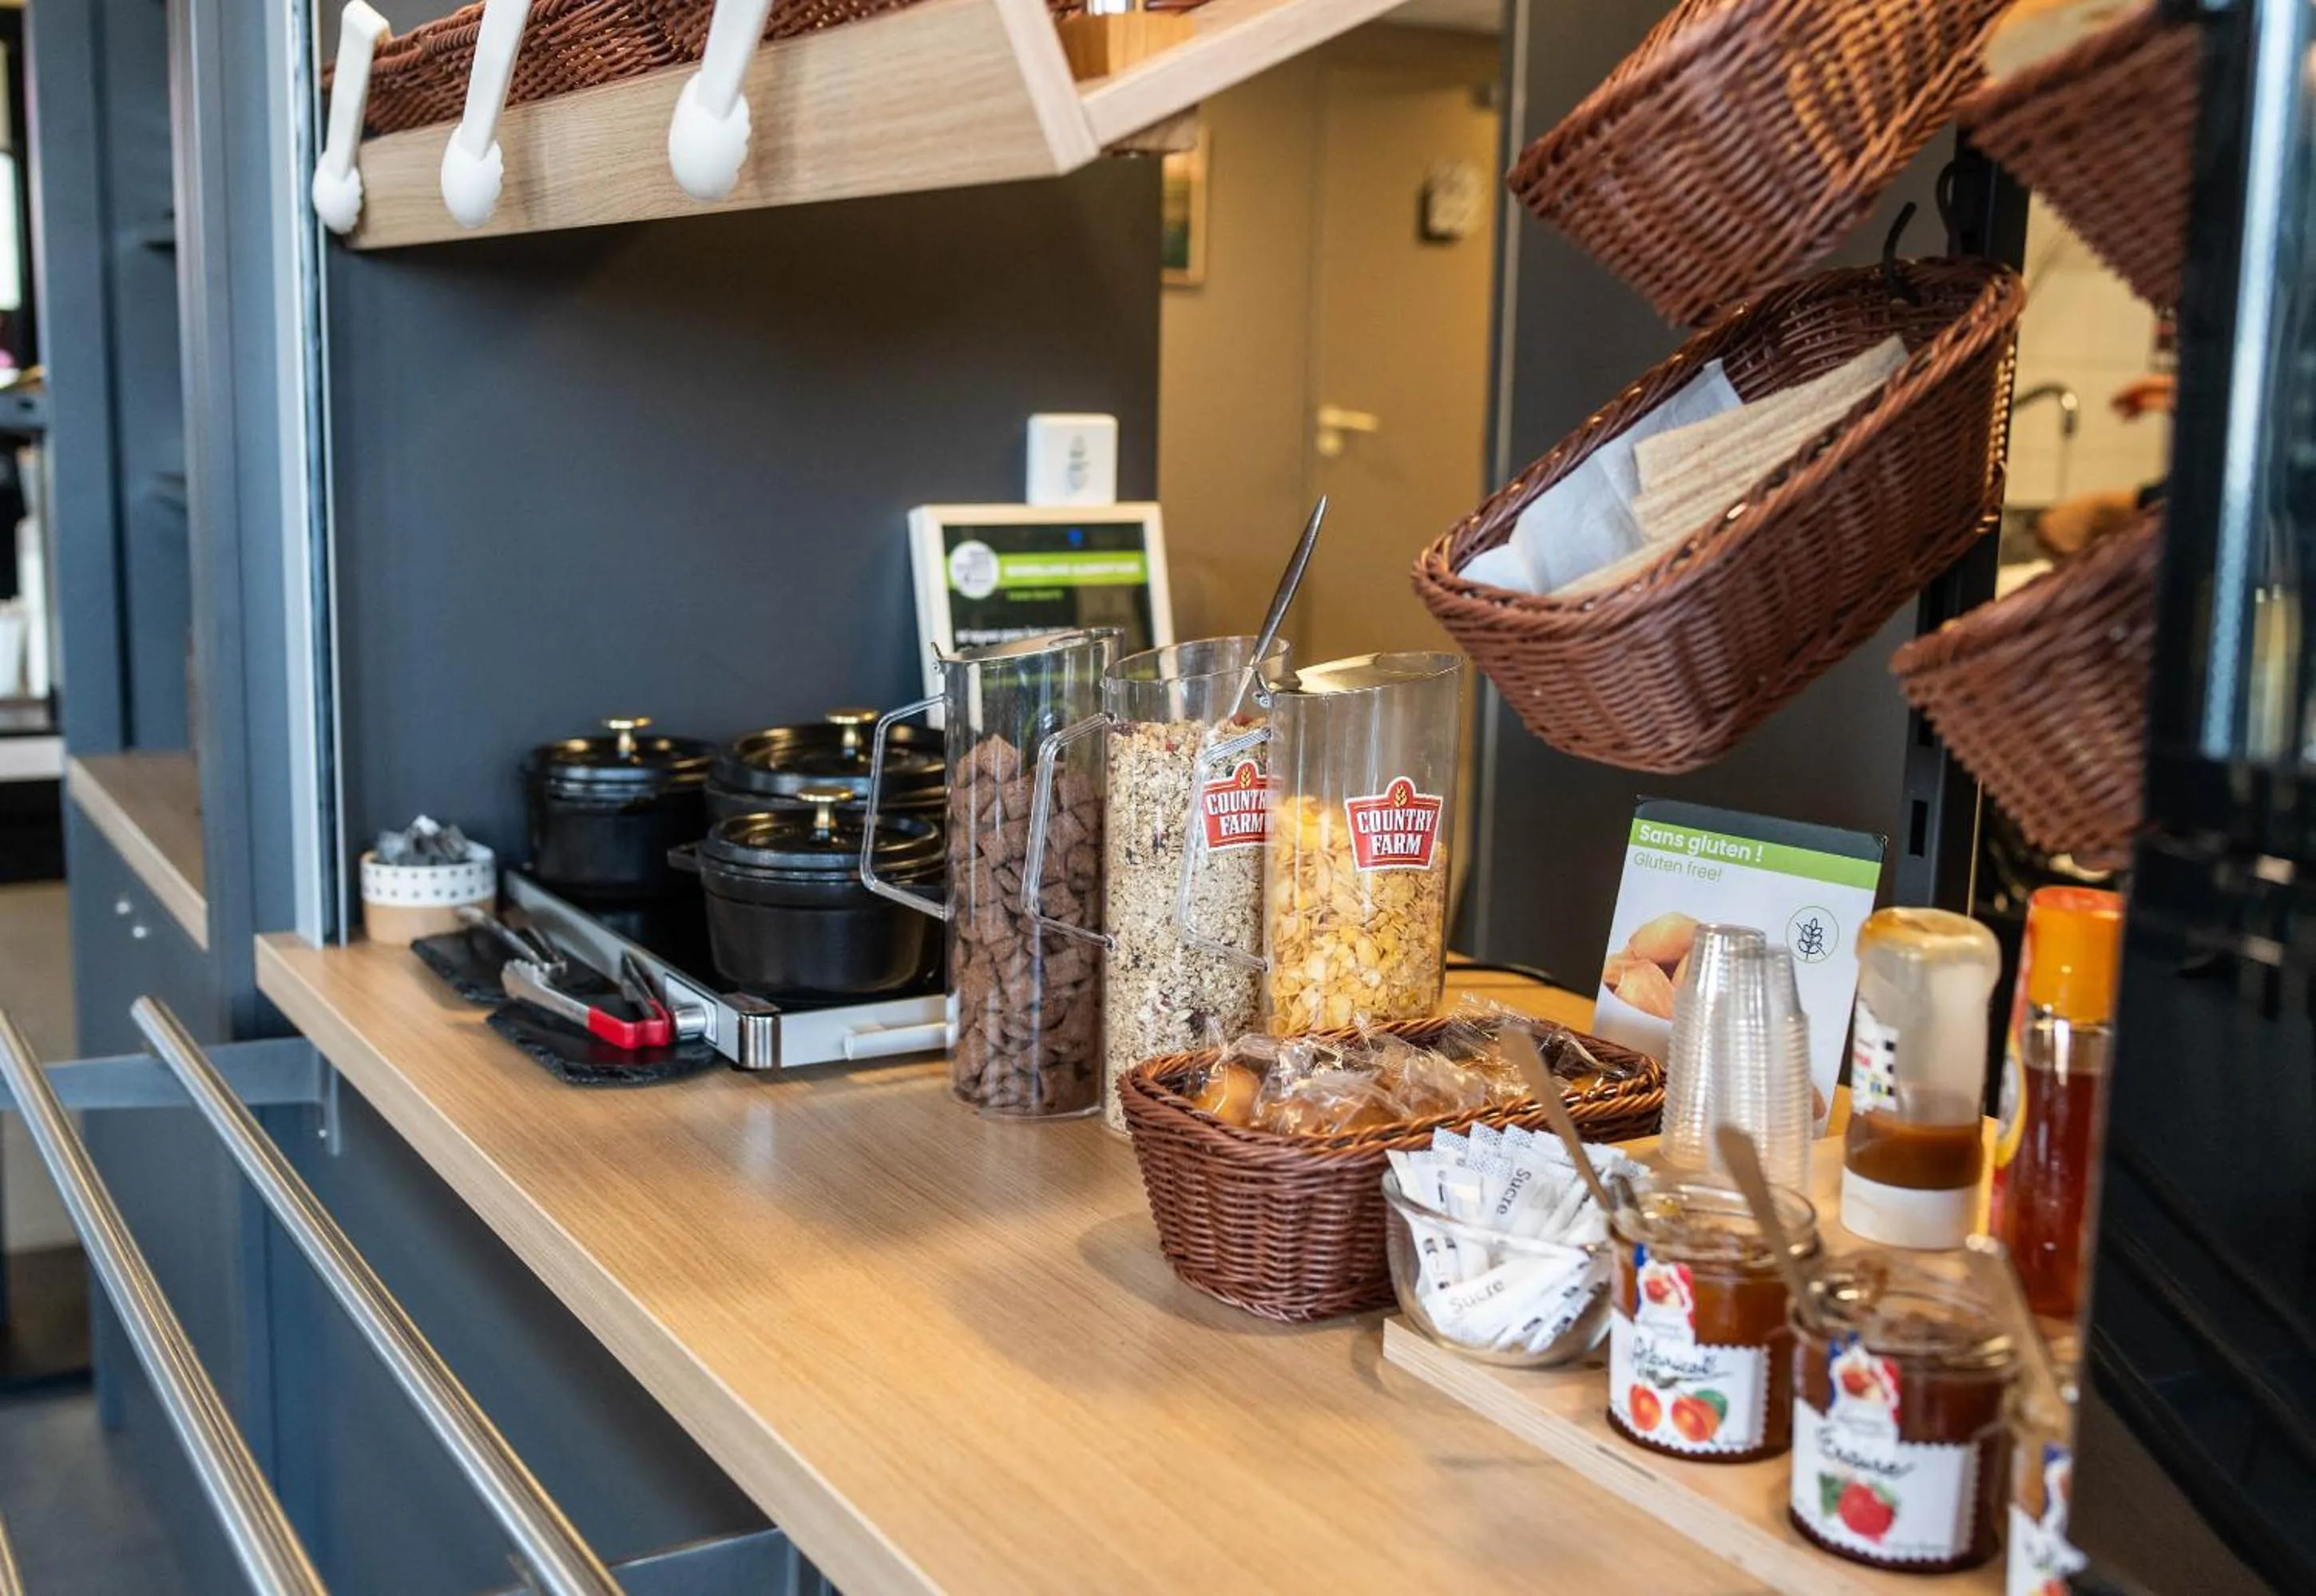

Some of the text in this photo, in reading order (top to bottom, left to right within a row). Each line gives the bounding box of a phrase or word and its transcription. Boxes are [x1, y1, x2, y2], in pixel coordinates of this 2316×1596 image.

[1219, 813, 1265, 837] FARM
[1357, 807, 1436, 833] COUNTRY
[1371, 833, 1422, 856] FARM
[1639, 825, 1683, 848] Sans
[1687, 836, 1751, 861] gluten
[1634, 852, 1723, 882] Gluten free!
[1497, 1168, 1532, 1214] Sucre
[1448, 1279, 1505, 1314] Sucre
